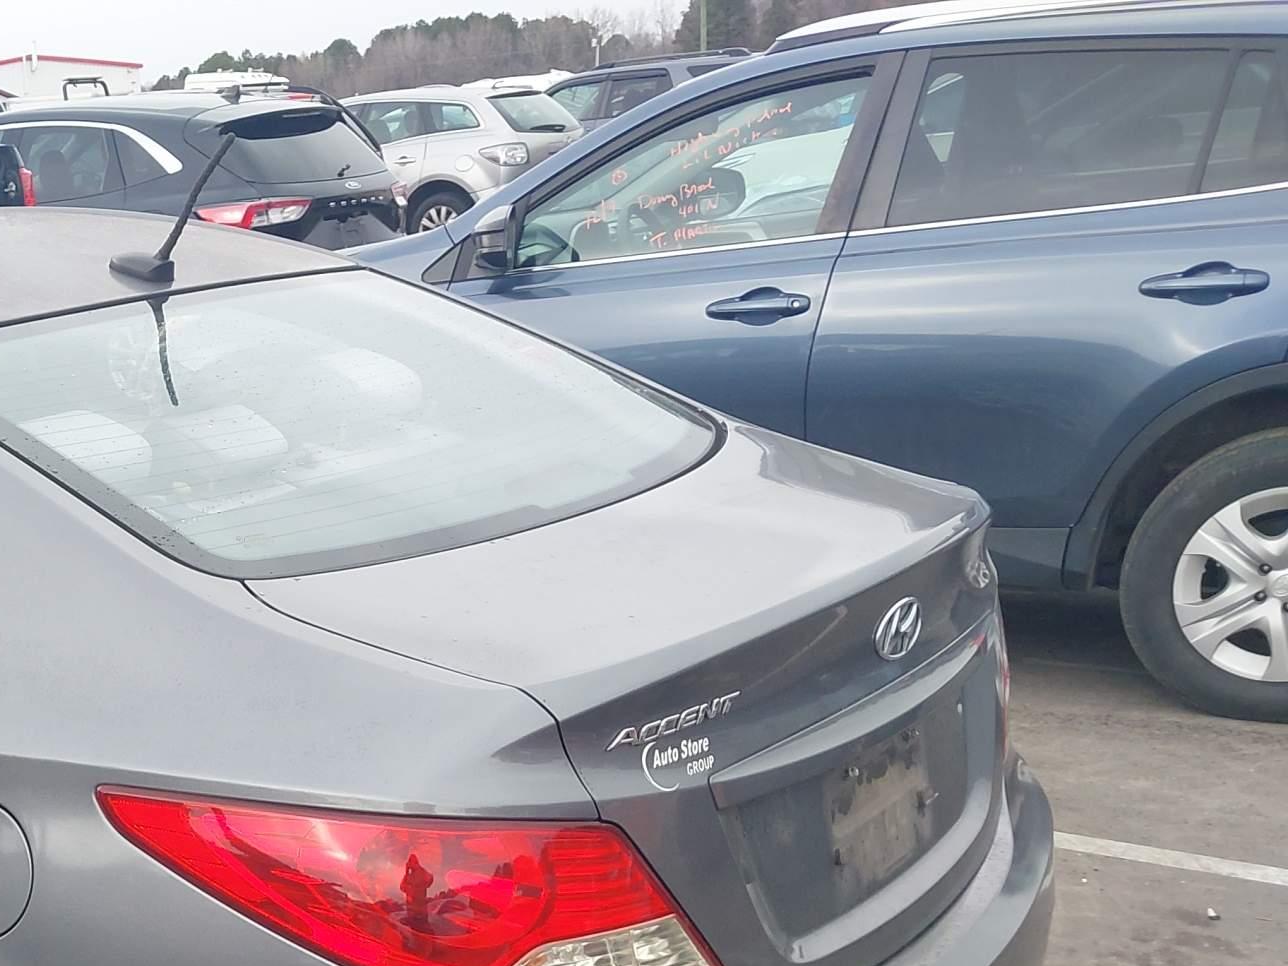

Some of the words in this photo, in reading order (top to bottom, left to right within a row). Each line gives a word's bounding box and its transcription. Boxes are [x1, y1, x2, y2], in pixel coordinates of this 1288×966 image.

[606, 690, 741, 752] ACCENT
[653, 746, 679, 769] Auto
[680, 737, 709, 759] Store
[687, 755, 715, 776] GROUP
